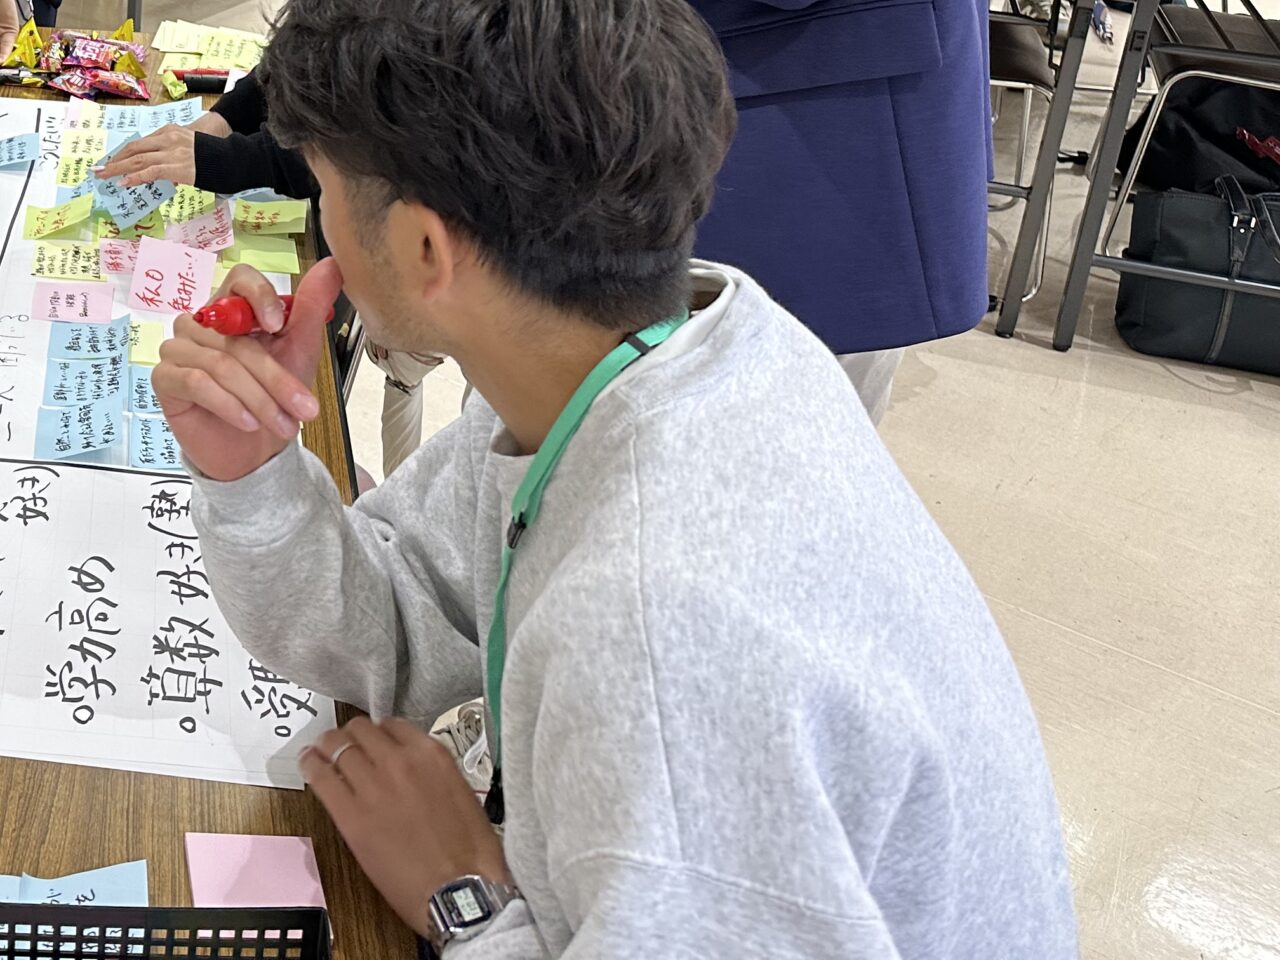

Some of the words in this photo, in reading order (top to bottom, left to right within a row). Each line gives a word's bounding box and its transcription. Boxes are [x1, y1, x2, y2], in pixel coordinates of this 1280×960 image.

[13, 465, 61, 525] 好き)
[45, 556, 120, 704] 学力高め
